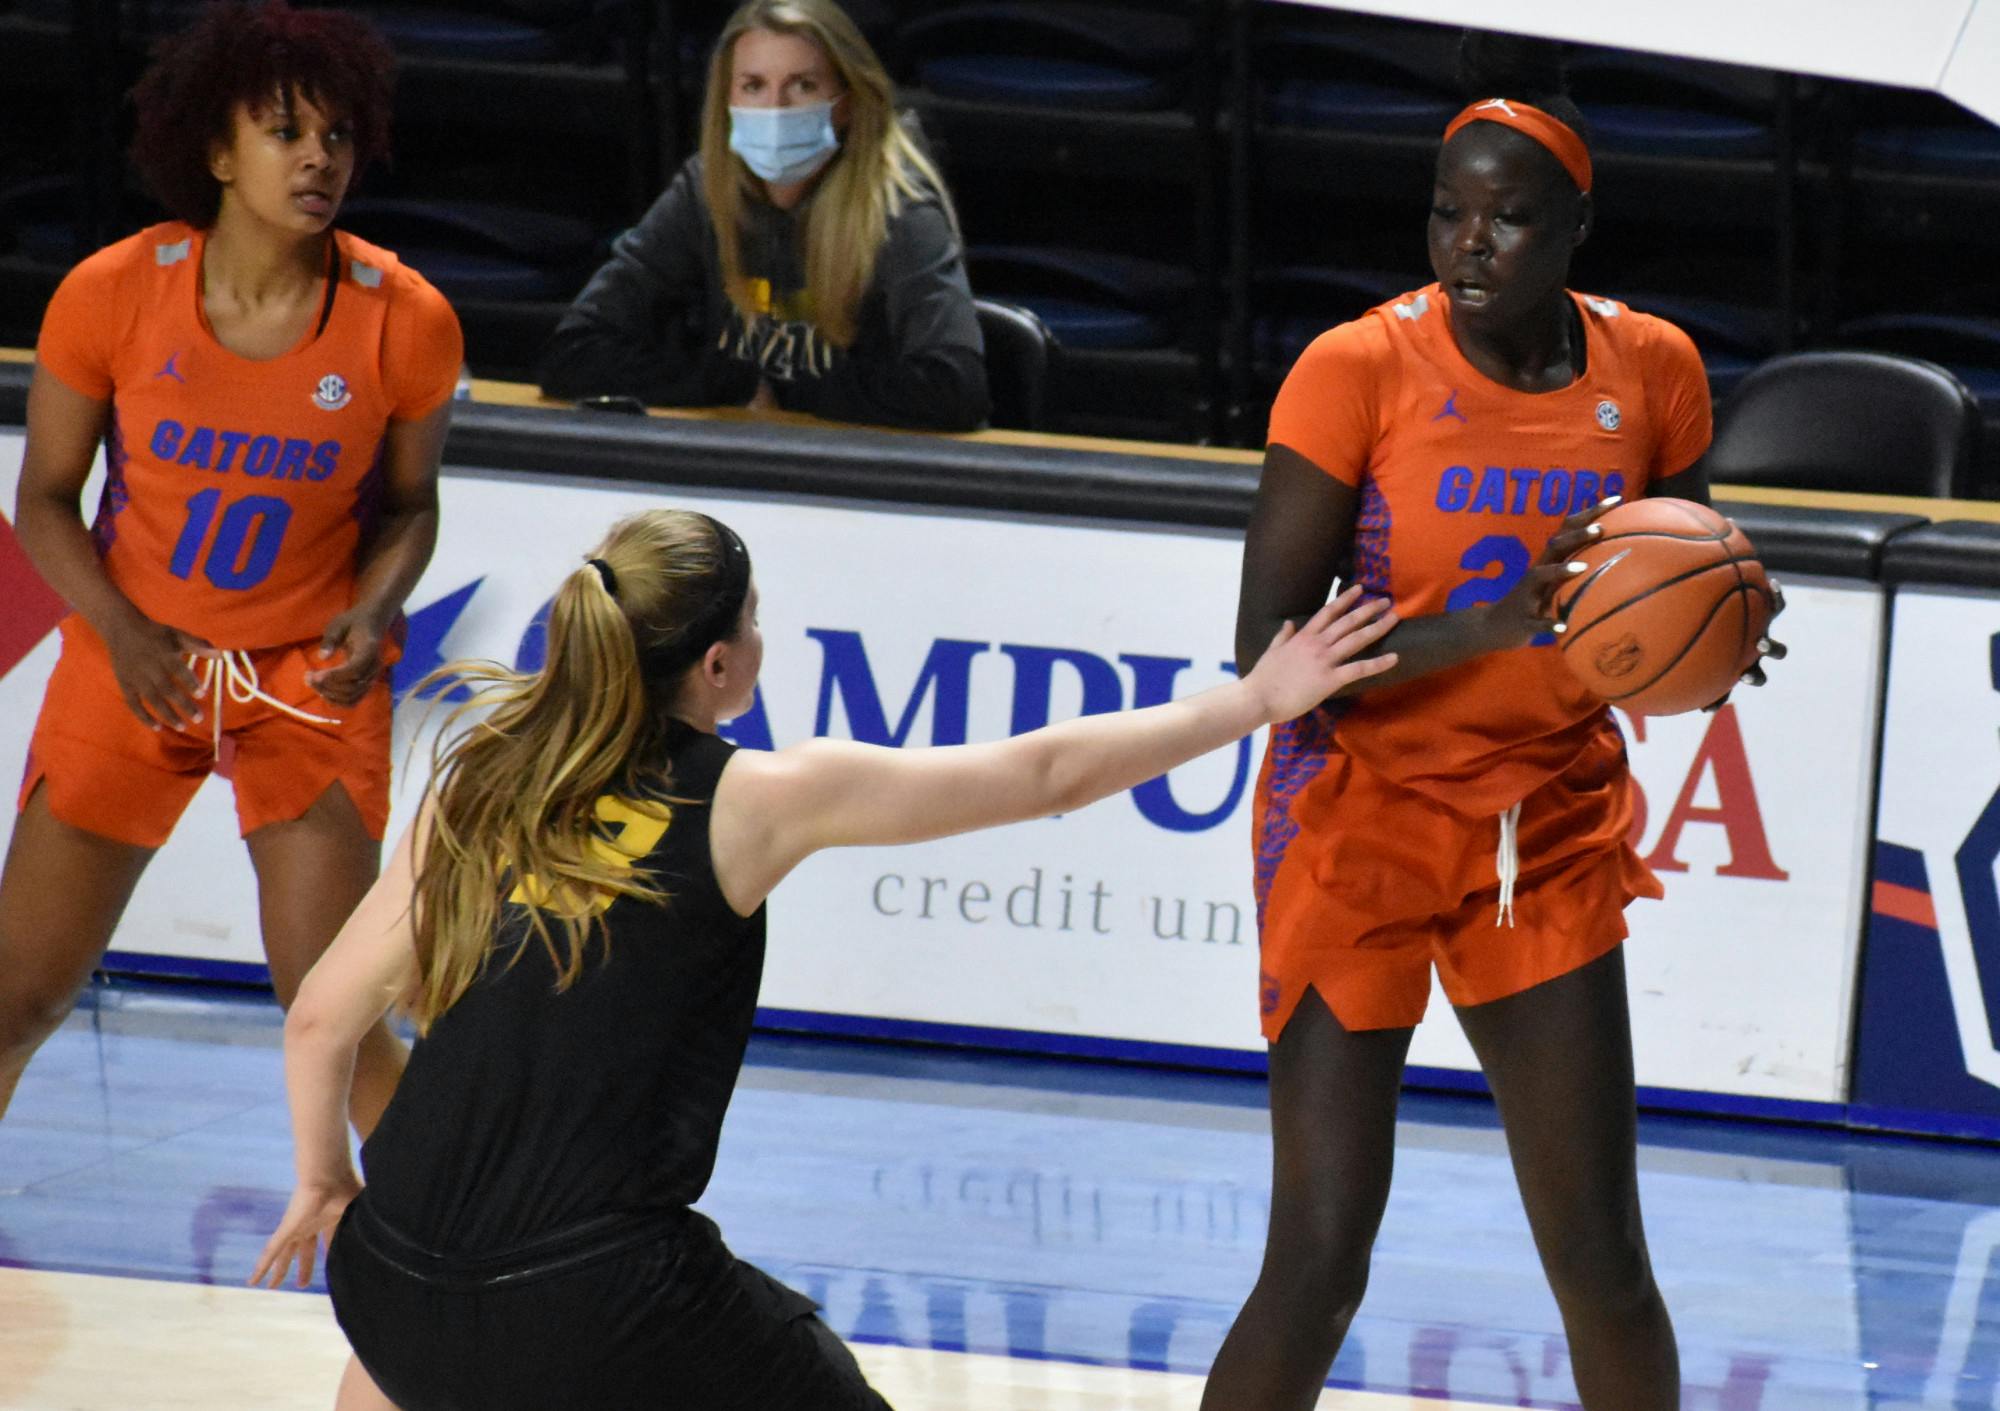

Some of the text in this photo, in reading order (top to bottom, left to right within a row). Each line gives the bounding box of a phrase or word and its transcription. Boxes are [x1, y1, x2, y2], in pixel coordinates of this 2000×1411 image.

[150, 419, 342, 481] GATORS
[168, 487, 294, 590] 10
[872, 867, 1245, 946] credit un
